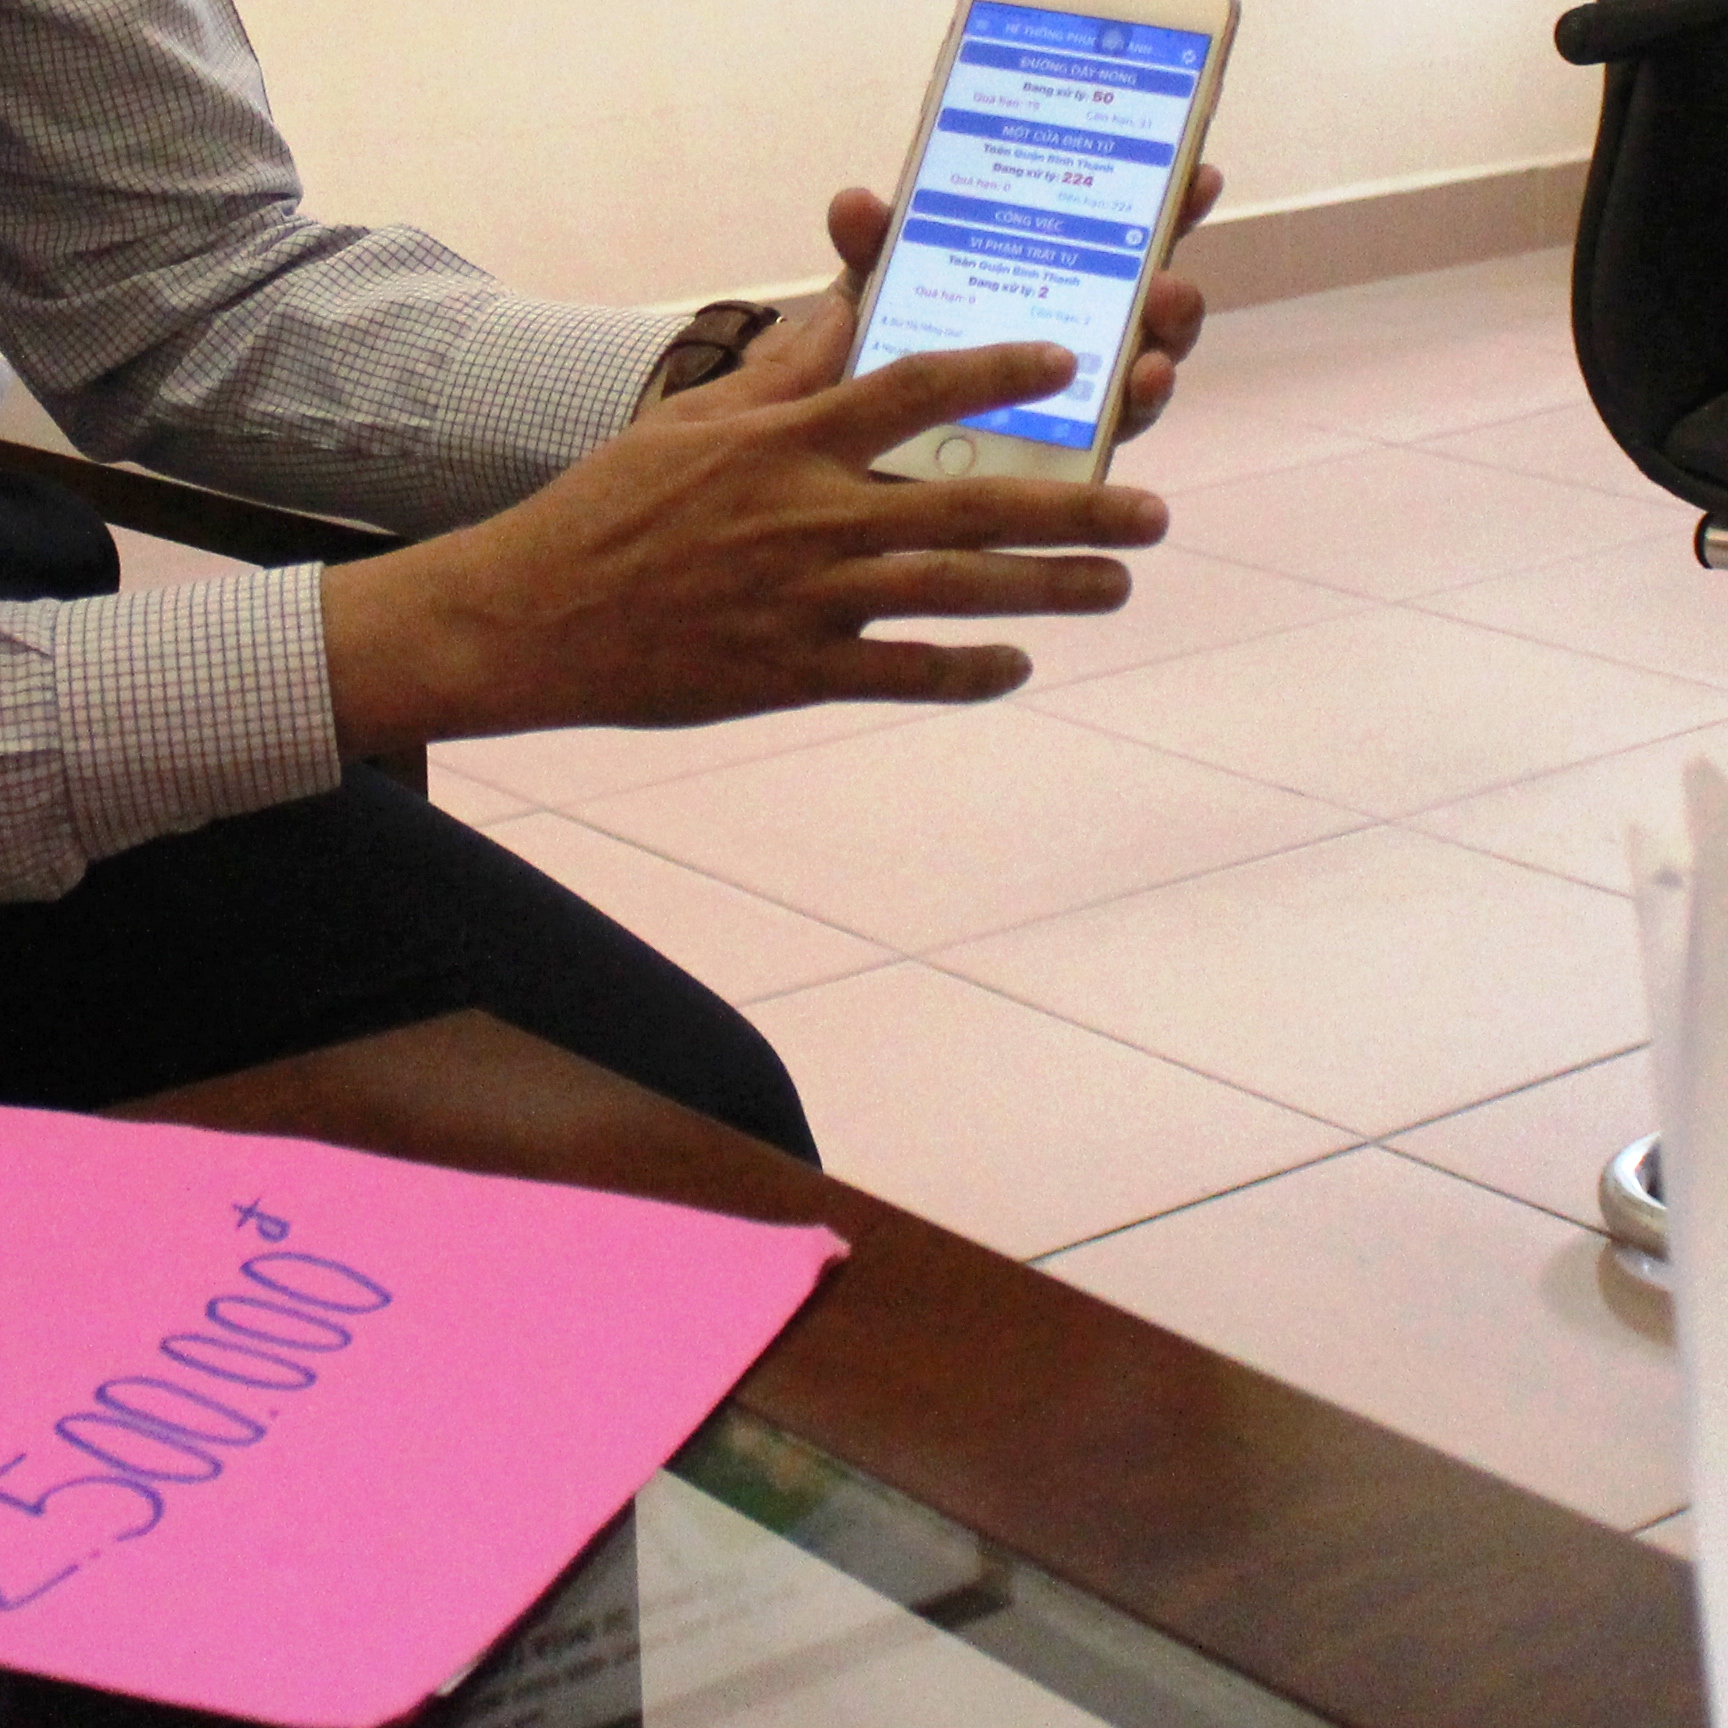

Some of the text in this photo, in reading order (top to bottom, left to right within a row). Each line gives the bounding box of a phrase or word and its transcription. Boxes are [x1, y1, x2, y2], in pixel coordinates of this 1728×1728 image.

[1092, 90, 1115, 104] 50
[1062, 171, 1094, 187] 224
[1038, 286, 1049, 299] 2
